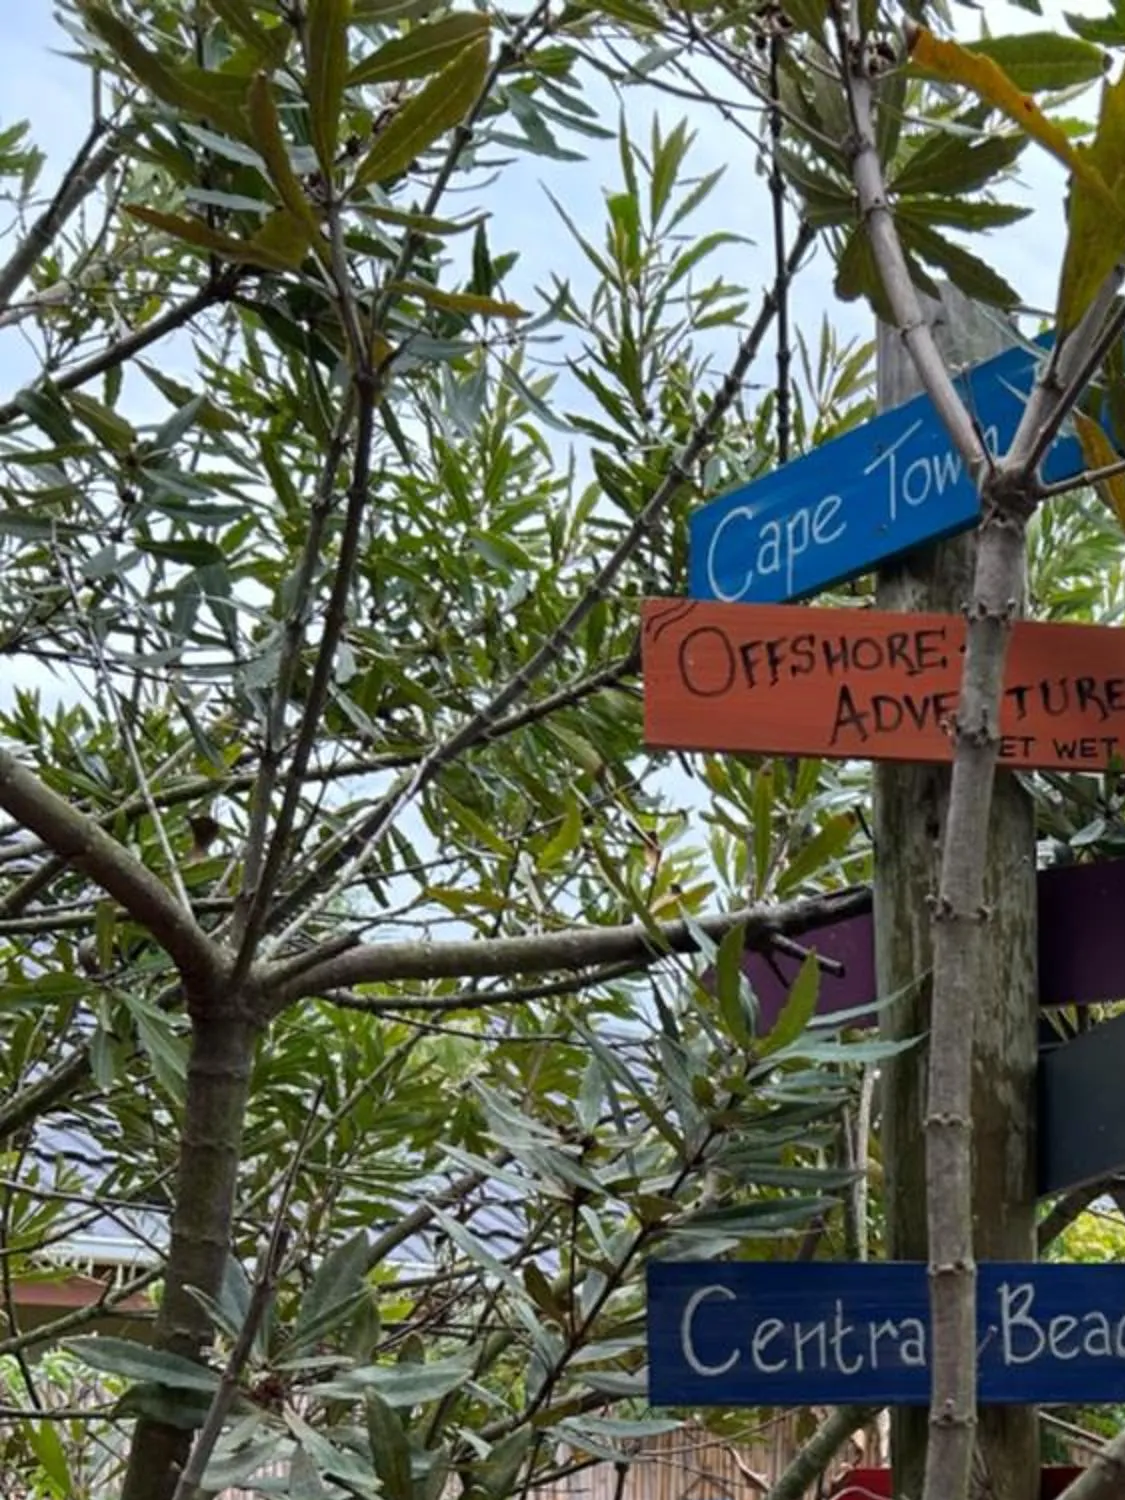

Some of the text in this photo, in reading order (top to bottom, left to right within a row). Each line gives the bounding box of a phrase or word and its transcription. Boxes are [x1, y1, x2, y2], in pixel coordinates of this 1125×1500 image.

[707, 506, 846, 601] Cape
[678, 626, 948, 697] OFFSHORE
[998, 735, 1037, 758] ET
[1052, 736, 1119, 761] WET
[681, 1284, 927, 1376] Centra
